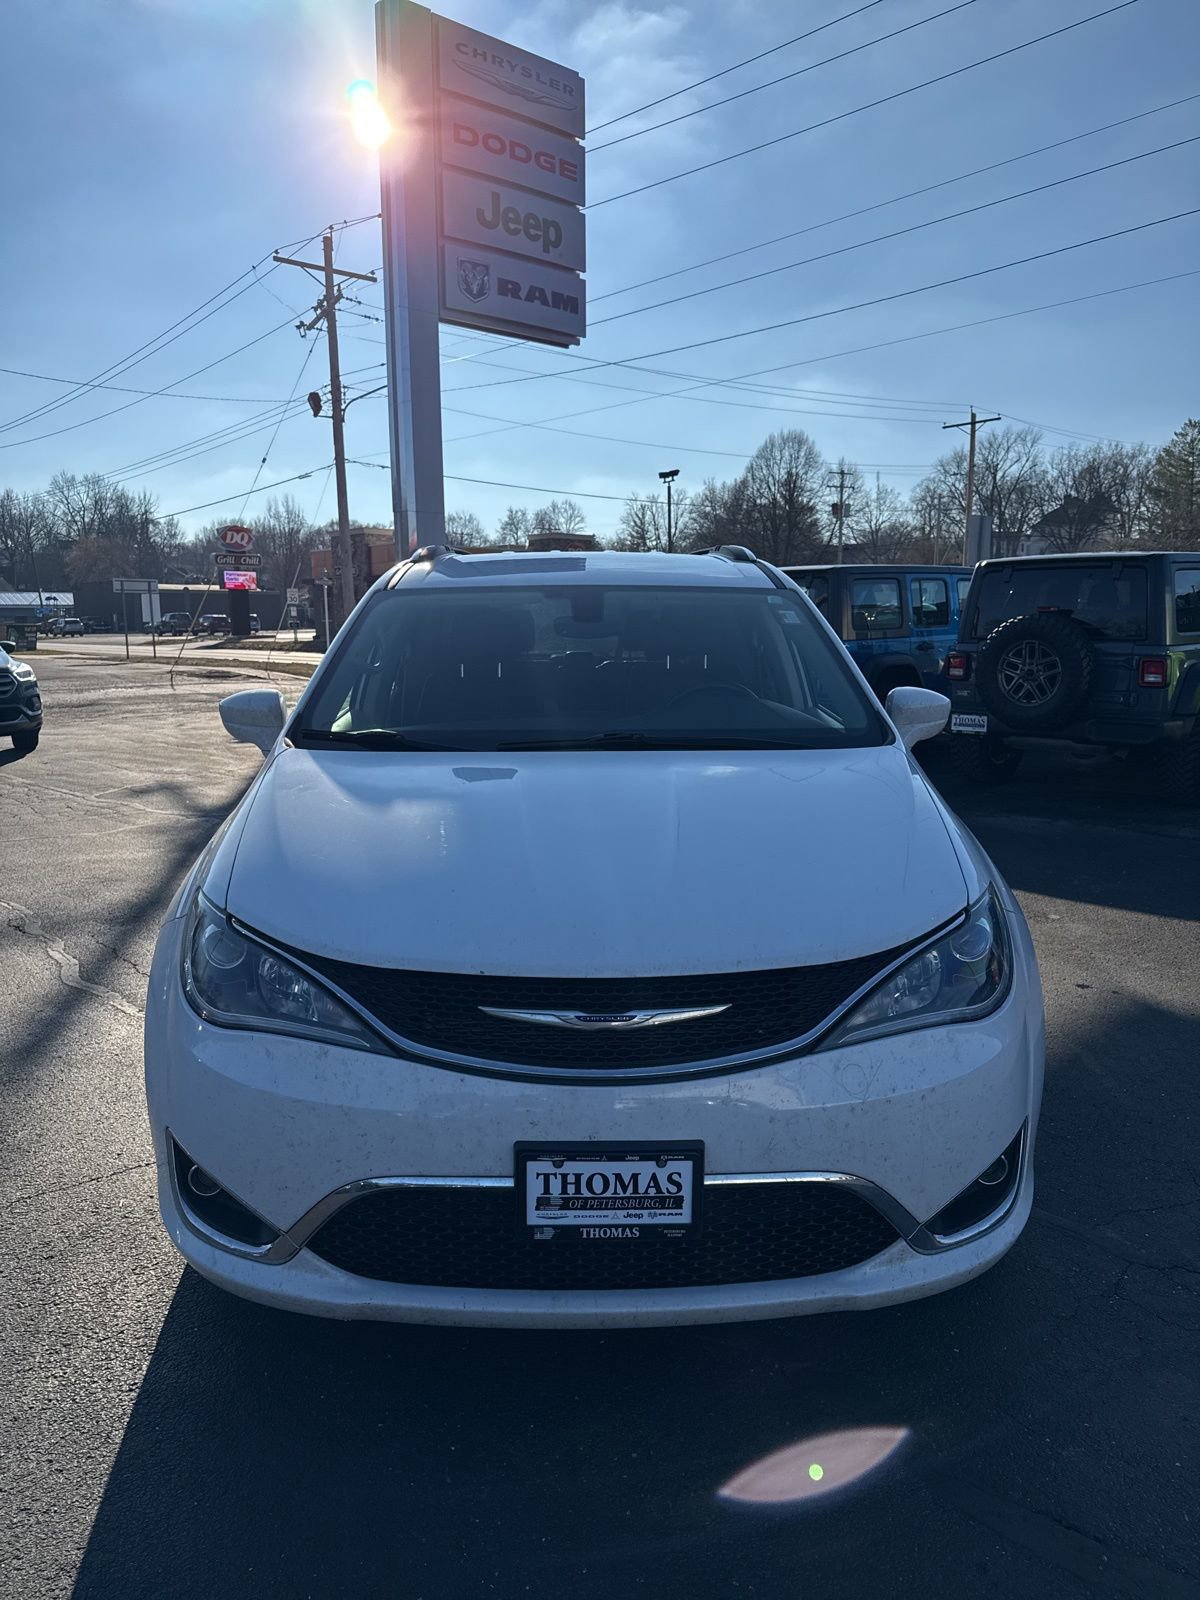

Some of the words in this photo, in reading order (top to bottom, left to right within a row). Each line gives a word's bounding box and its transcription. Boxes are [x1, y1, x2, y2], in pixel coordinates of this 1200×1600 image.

[455, 42, 575, 97] CHRYSLER
[453, 122, 578, 182] DODGE
[476, 191, 562, 254] Jeep
[497, 277, 579, 315] RAM
[226, 531, 249, 546] DQ
[217, 556, 235, 564] Grill
[240, 556, 259, 564] Chill
[536, 1172, 683, 1196] THOMAS
[569, 1199, 584, 1208] OF
[586, 1199, 662, 1209] PETERSBURG,
[664, 1199, 676, 1208] IL
[580, 1227, 640, 1239] THOMAS
